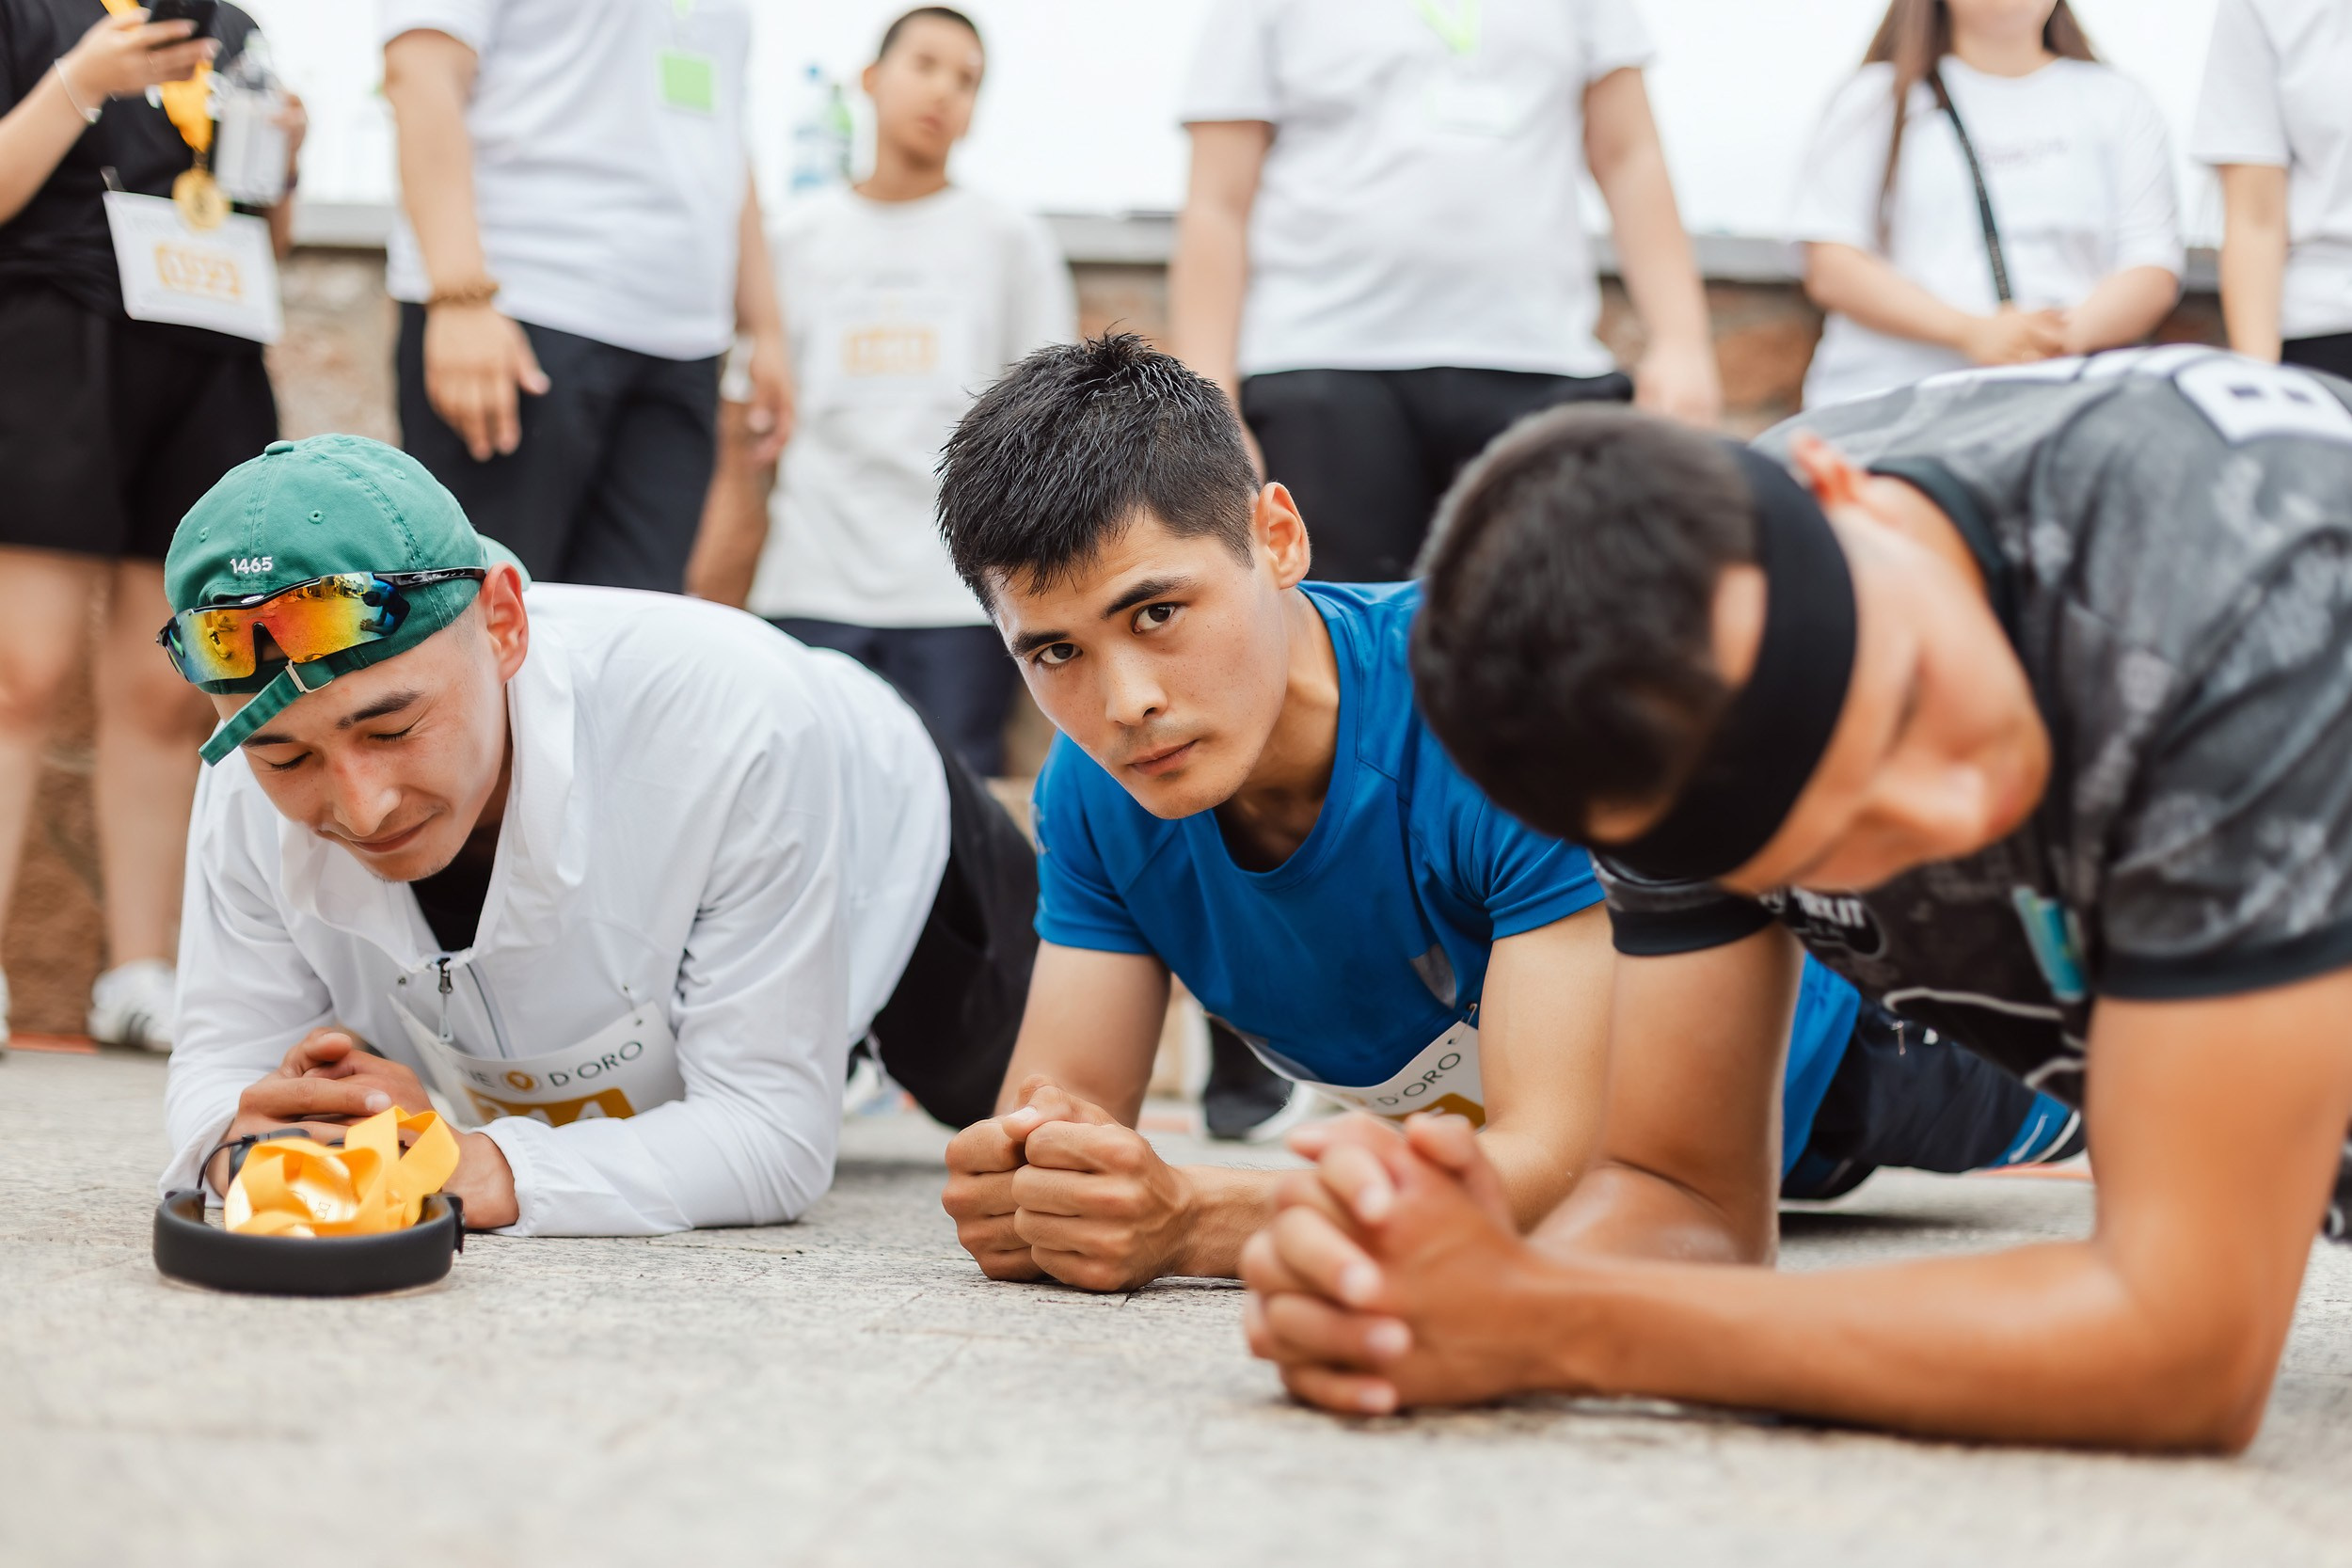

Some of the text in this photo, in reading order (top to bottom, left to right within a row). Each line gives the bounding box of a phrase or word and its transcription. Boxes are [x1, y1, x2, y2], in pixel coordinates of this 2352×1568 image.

[230, 556, 273, 574] 1465
[548, 1040, 644, 1087] D'ORO
[1377, 1053, 1461, 1106] D'ORO
